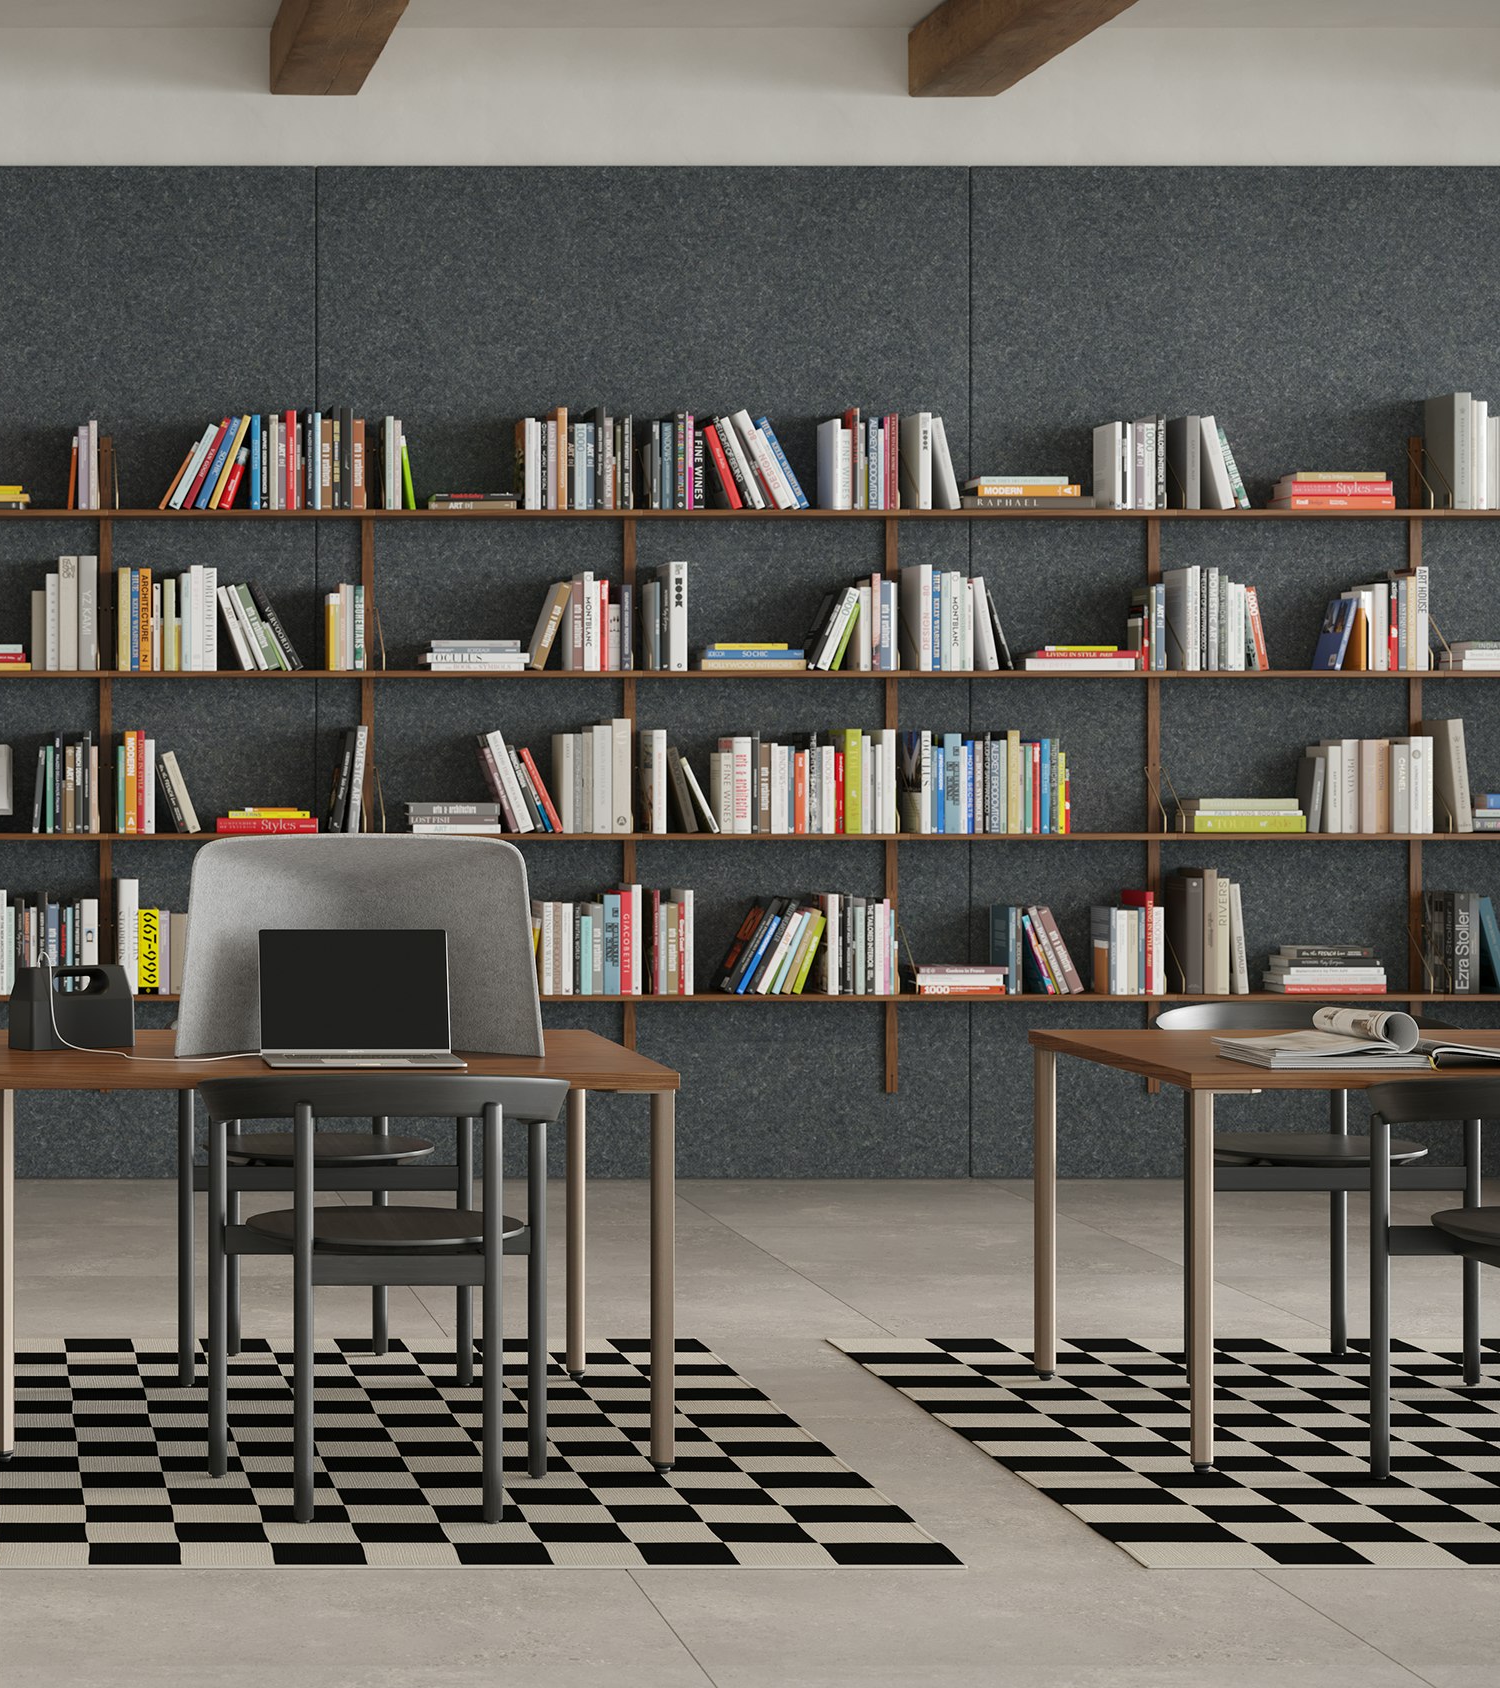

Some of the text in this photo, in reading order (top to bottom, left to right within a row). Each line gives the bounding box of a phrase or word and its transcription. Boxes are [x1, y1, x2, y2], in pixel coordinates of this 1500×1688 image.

[577, 426, 585, 452] 1000
[869, 419, 878, 503] ALEXEY BRODOVITCH
[1146, 426, 1154, 452] 1000
[199, 448, 216, 478] VAN GOGH
[211, 450, 228, 475] SO CHIC
[694, 440, 703, 499] FINE WINES
[771, 441, 786, 460] KELLY
[784, 461, 802, 496] WEARSTLER
[1222, 445, 1243, 489] BOHEMIANS
[977, 498, 1039, 506] RAPHAEL
[1336, 482, 1371, 495] Styles
[141, 574, 149, 642] ARCHITECTURE
[675, 578, 683, 608] BOOK
[841, 590, 858, 616] 1000
[1209, 573, 1217, 643] DOMESTIC ART
[1247, 590, 1258, 616] 1000
[1418, 569, 1427, 613] ART HOUSE
[83, 607, 92, 635] KAMI
[263, 606, 293, 653] VERVOORDT
[355, 604, 364, 649] BOHEMIANS
[435, 654, 482, 662] OCULUS
[126, 737, 134, 776] MODERN
[352, 731, 365, 805] DOMESTIC ART
[922, 739, 930, 787] OCULUS
[1398, 757, 1406, 792] CHANEL
[723, 764, 731, 823] FINE WINES
[991, 743, 999, 827] ALEXEY BRODOVITCH
[261, 819, 296, 833] Styles
[1218, 881, 1227, 926] RIVERS
[143, 912, 156, 984] 667-999
[544, 905, 552, 977] LIVING ON WATER
[1236, 936, 1245, 975] BAUHAUS
[1455, 909, 1470, 990] Ezra Stoller
[924, 986, 950, 994] 1000
